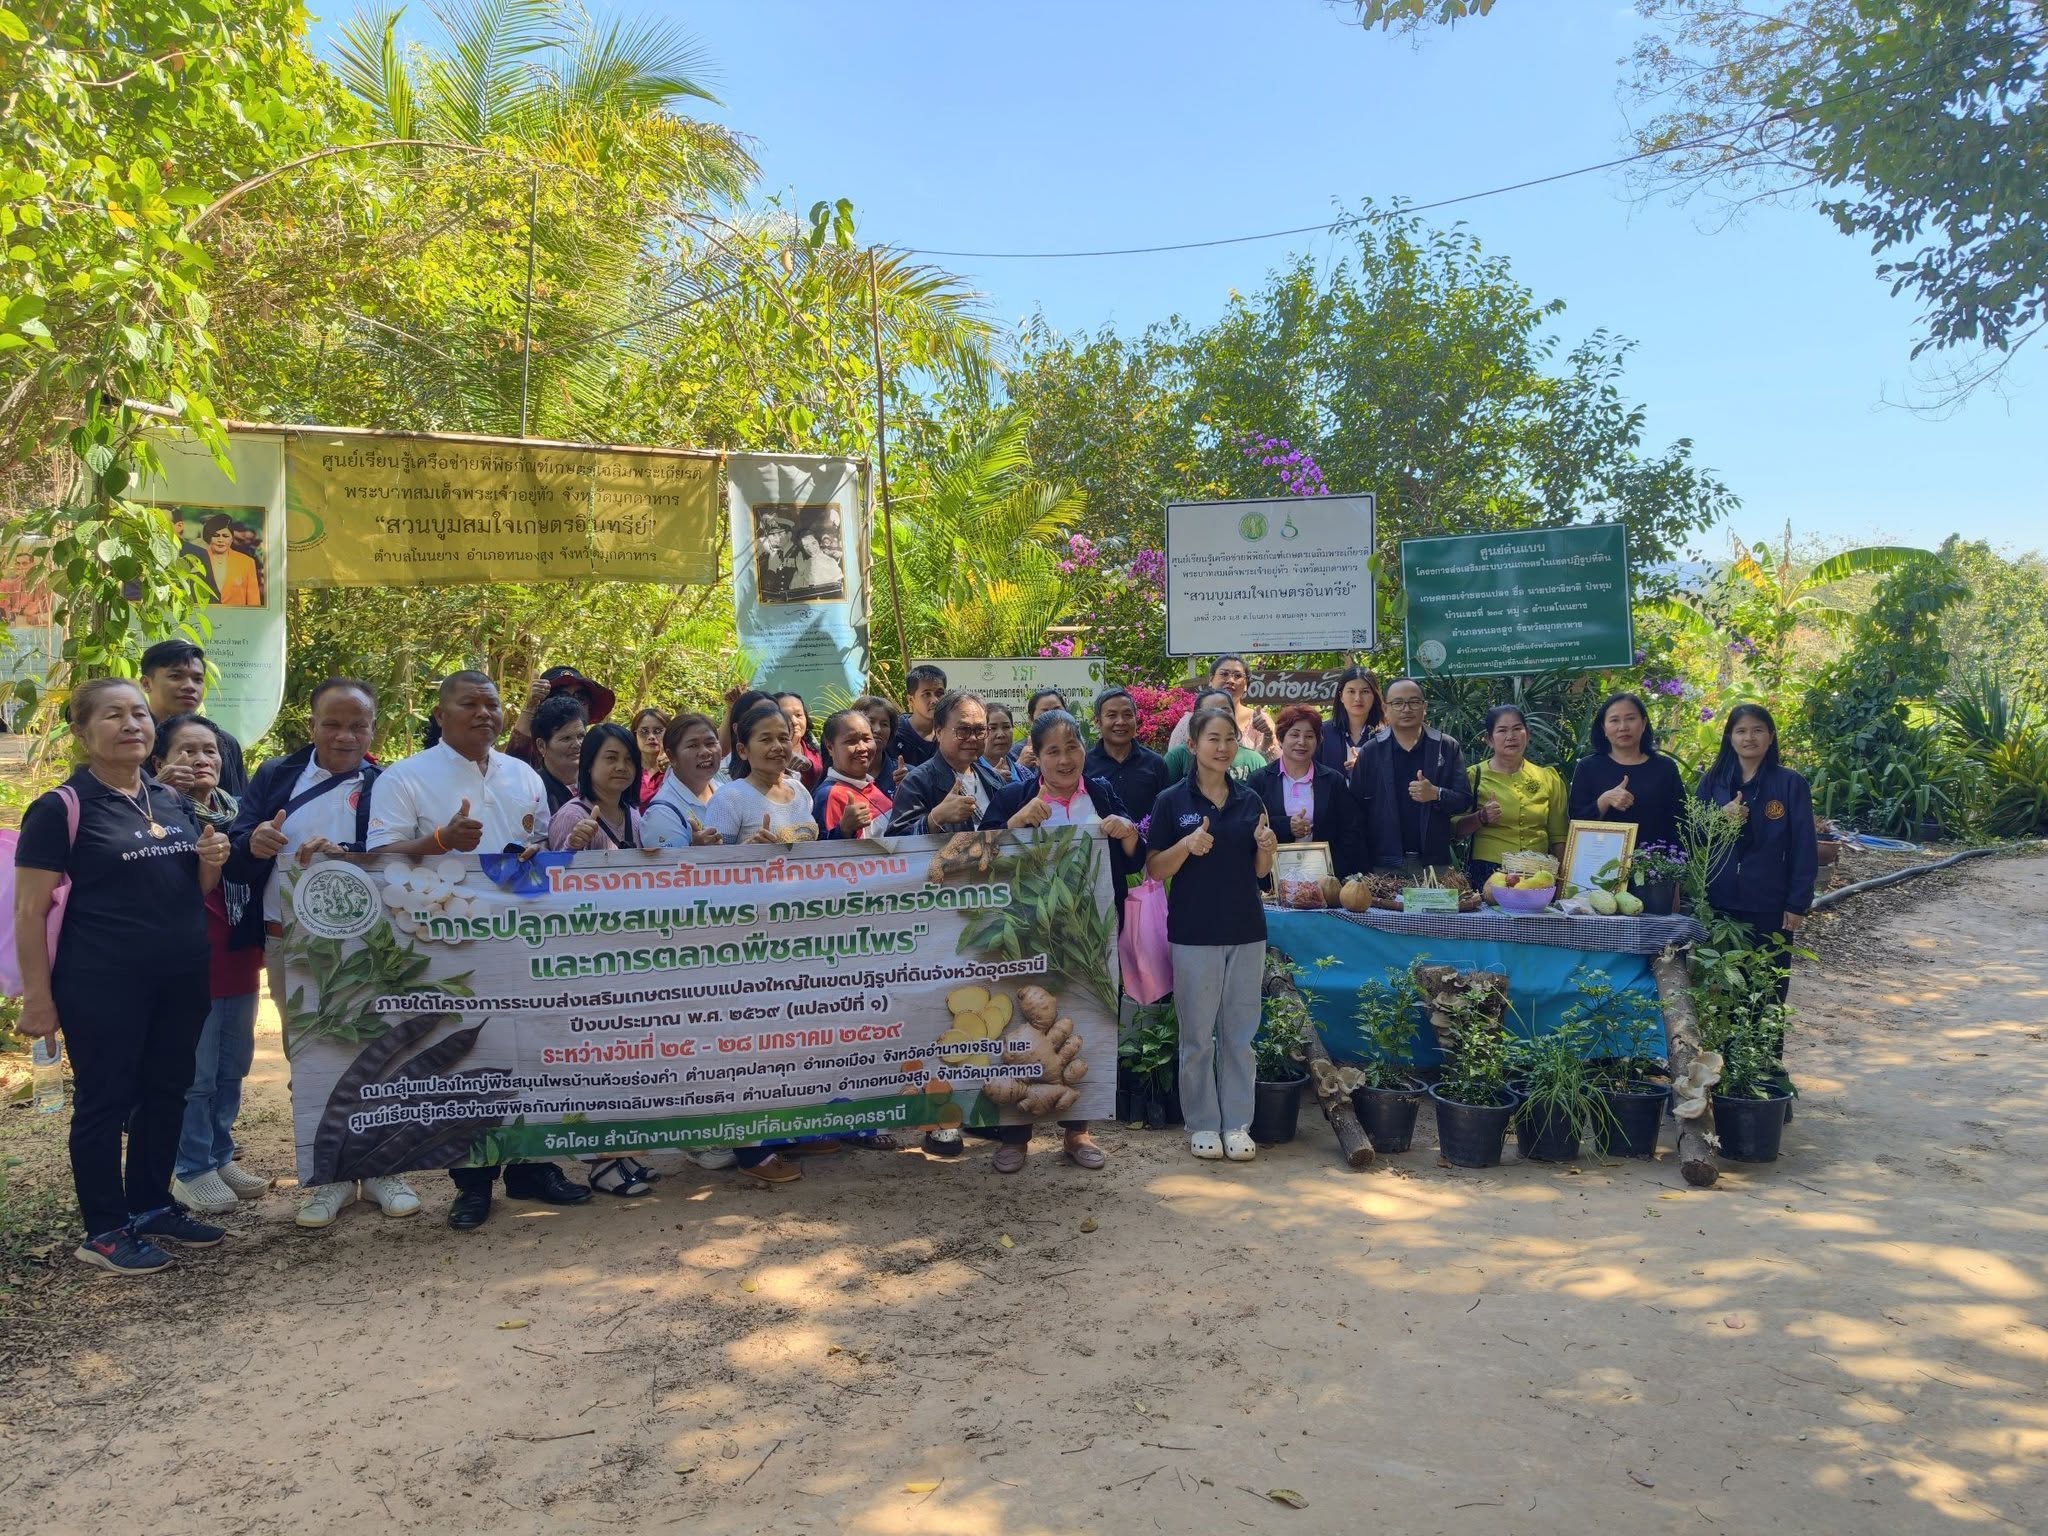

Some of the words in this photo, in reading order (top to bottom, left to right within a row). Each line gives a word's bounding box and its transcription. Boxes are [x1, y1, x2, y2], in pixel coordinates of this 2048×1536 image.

[344, 482, 554, 506] พระบาทสมเด็จพระเจ้าอยู่หัว
[374, 548, 459, 562] ตำบลโนนยาง
[466, 548, 554, 564] อำเภอหนองสูง
[1479, 543, 1546, 560] ศูนย์ต้นแบบ
[548, 857, 908, 893] โครงการสัมมนาศึกษาดูงาน
[768, 884, 1011, 922] การบริหารจัดการ
[377, 956, 1046, 1012] ภายใต้โครงการระบบส่งเสริมเกษตรแบบแปลงใหญ่ในเขตปฏิรูปที่ดินจังหวัดอุดรธานี
[571, 1013, 681, 1033] ปีงบประมาณ
[688, 1009, 723, 1023] พ.ศ.
[729, 1005, 781, 1021] ๒๕๖๙
[786, 993, 864, 1019] (แปลงปีที่
[871, 994, 888, 1013] ๑)
[543, 1033, 655, 1063] ระหว่างวันที่
[660, 1039, 695, 1057] ๒๕
[718, 1035, 752, 1053] ๒๘
[758, 1028, 833, 1051] มกราคม
[839, 1022, 904, 1042] ๒๕๖๙
[686, 1061, 796, 1083] ตำบลกุดปลาดุก
[803, 1052, 875, 1072] อำเภอเมือง
[883, 1039, 1003, 1063] จังหวัดอำนาจเจริญ
[1009, 1040, 1031, 1053] และ
[742, 1082, 832, 1102] ตำบลโนนยาง
[838, 1070, 930, 1094] อำเภอหนองสูง
[937, 1063, 1042, 1084] จังหวัดมุกดาหาร
[544, 1129, 599, 1149] จัดโดย
[604, 1104, 907, 1147] สำนักงานการปฏิรูปที่ดินจังหวัดอุดรธานี
